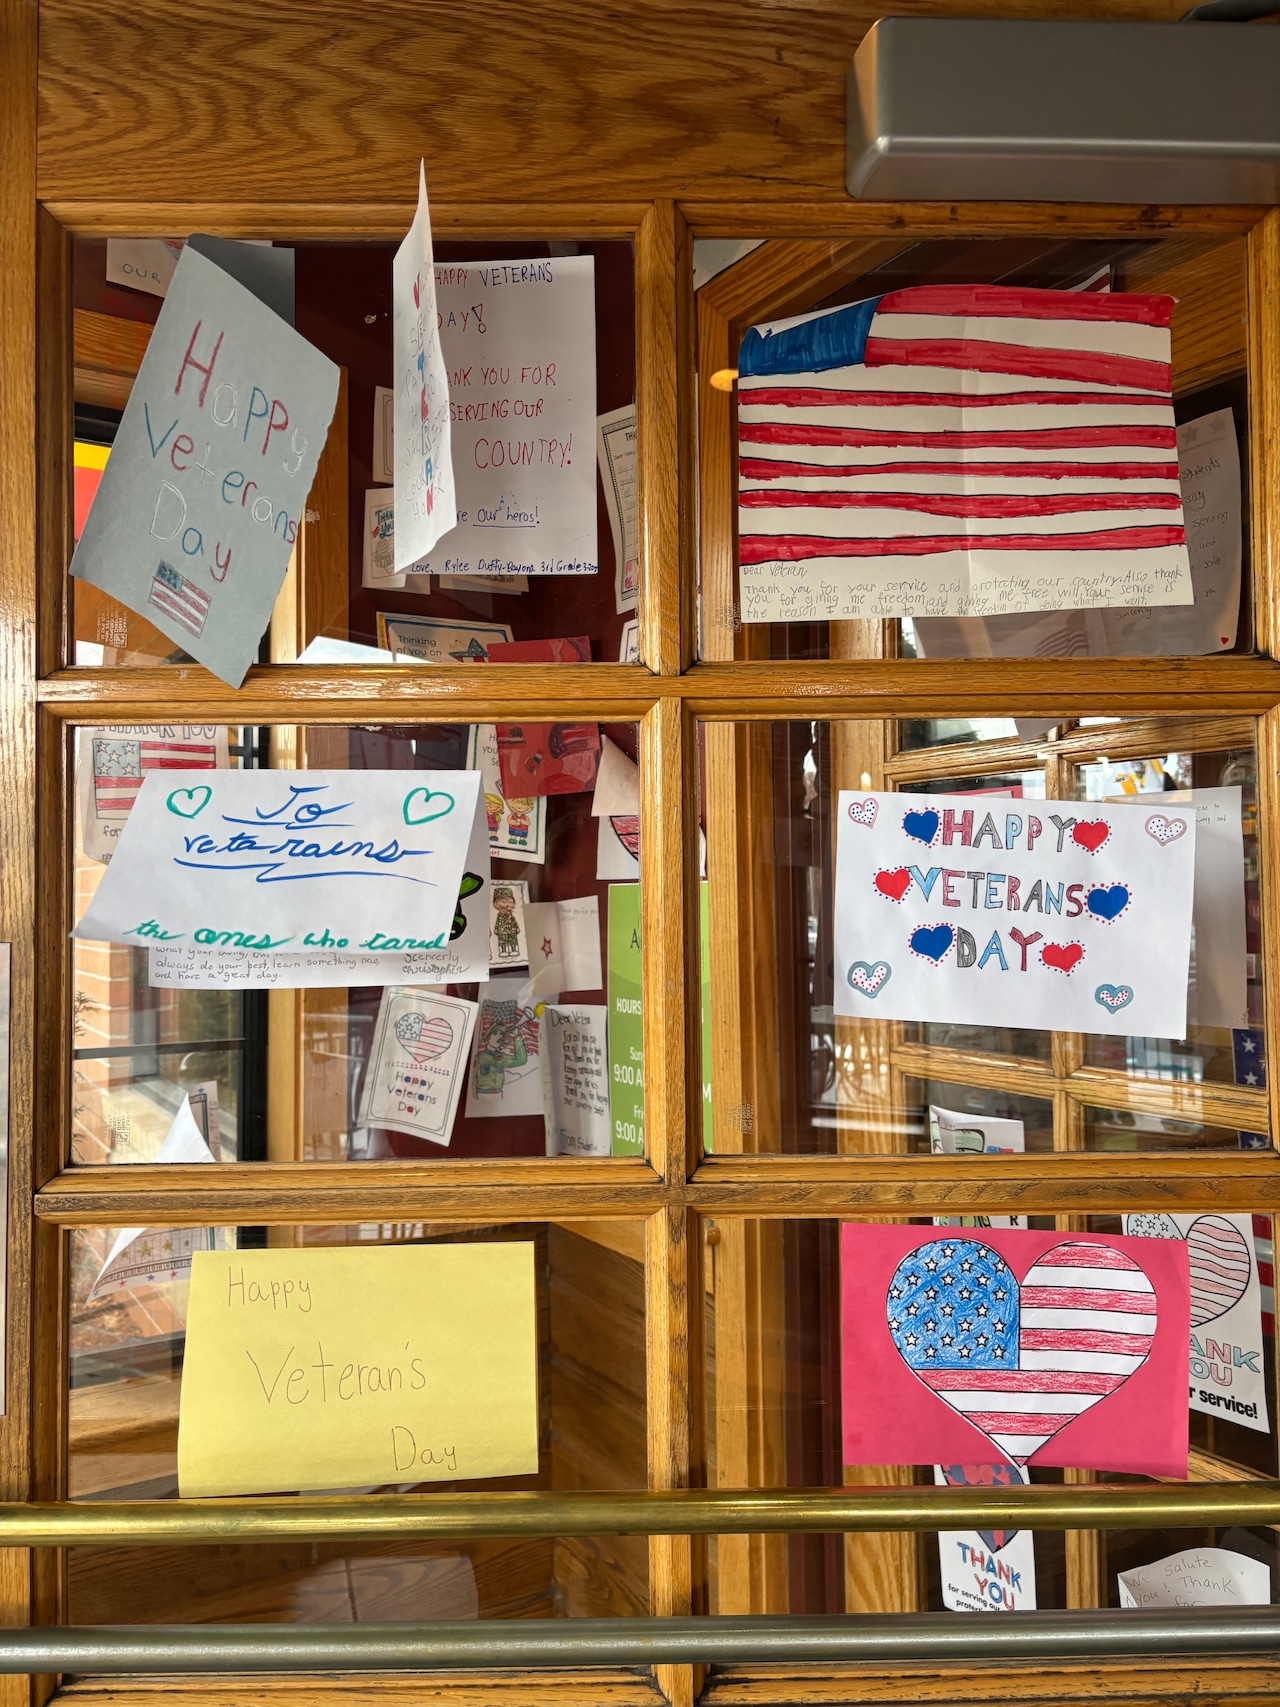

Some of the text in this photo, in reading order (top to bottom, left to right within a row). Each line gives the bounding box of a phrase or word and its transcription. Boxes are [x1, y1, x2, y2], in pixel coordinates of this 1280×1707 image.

[122, 263, 161, 284] OUR
[479, 262, 553, 287] VETERANS
[447, 363, 556, 387] ANK YOU FOR
[174, 319, 308, 477] Happy
[450, 398, 544, 422] SERVING OUR
[474, 432, 573, 469] COUNTRY!
[144, 401, 297, 545] Veterans
[457, 510, 468, 522] re
[506, 506, 540, 524] heros!
[149, 479, 232, 583] Day
[411, 562, 434, 574] Love,
[444, 559, 470, 573] Rylee
[541, 558, 554, 574] 3rd
[556, 558, 582, 572] Grade
[744, 565, 764, 576] Dear
[744, 582, 780, 594] Thank
[792, 587, 811, 598] you
[821, 581, 838, 595] for
[848, 583, 877, 596] your
[939, 579, 961, 593] and
[1037, 577, 1064, 587] our
[1154, 564, 1183, 580] thank
[746, 595, 772, 608] you
[780, 594, 796, 607] for
[850, 594, 866, 604] me
[999, 590, 1017, 601] me
[746, 605, 768, 619] the
[842, 605, 860, 615] am
[902, 604, 914, 616] to
[398, 635, 437, 647] Thinking
[408, 648, 426, 656] you
[256, 785, 355, 823] To
[942, 809, 1077, 853] HAPPY
[908, 865, 1084, 917] VETERANS
[123, 920, 187, 940] the
[195, 928, 296, 949] ones
[956, 926, 1044, 971] DAY
[155, 971, 171, 979] and
[178, 971, 200, 980] have
[257, 971, 282, 982] day.
[156, 957, 194, 973] always
[200, 960, 213, 970] do
[218, 964, 242, 974] your
[273, 959, 301, 968] learn
[307, 955, 356, 969] something
[616, 998, 642, 1015] HOURS
[396, 1072, 434, 1090] Happy
[614, 1064, 634, 1085] 9:00
[636, 1072, 643, 1087] A
[388, 1085, 437, 1105] Veterans
[398, 1101, 421, 1117] Day
[616, 1120, 636, 1143] 9:00
[227, 1265, 312, 1313] Happy
[1189, 1333, 1261, 1374] ANK
[245, 1341, 427, 1405] Veteran's
[1189, 1357, 1232, 1387] OU
[1199, 1389, 1258, 1419] service!
[390, 1425, 458, 1471] Day
[957, 1541, 1022, 1594] THANK
[948, 1583, 959, 1593] for
[961, 1589, 988, 1607] serving
[974, 1573, 1015, 1611] YOU
[1178, 1576, 1236, 1595] Thank
